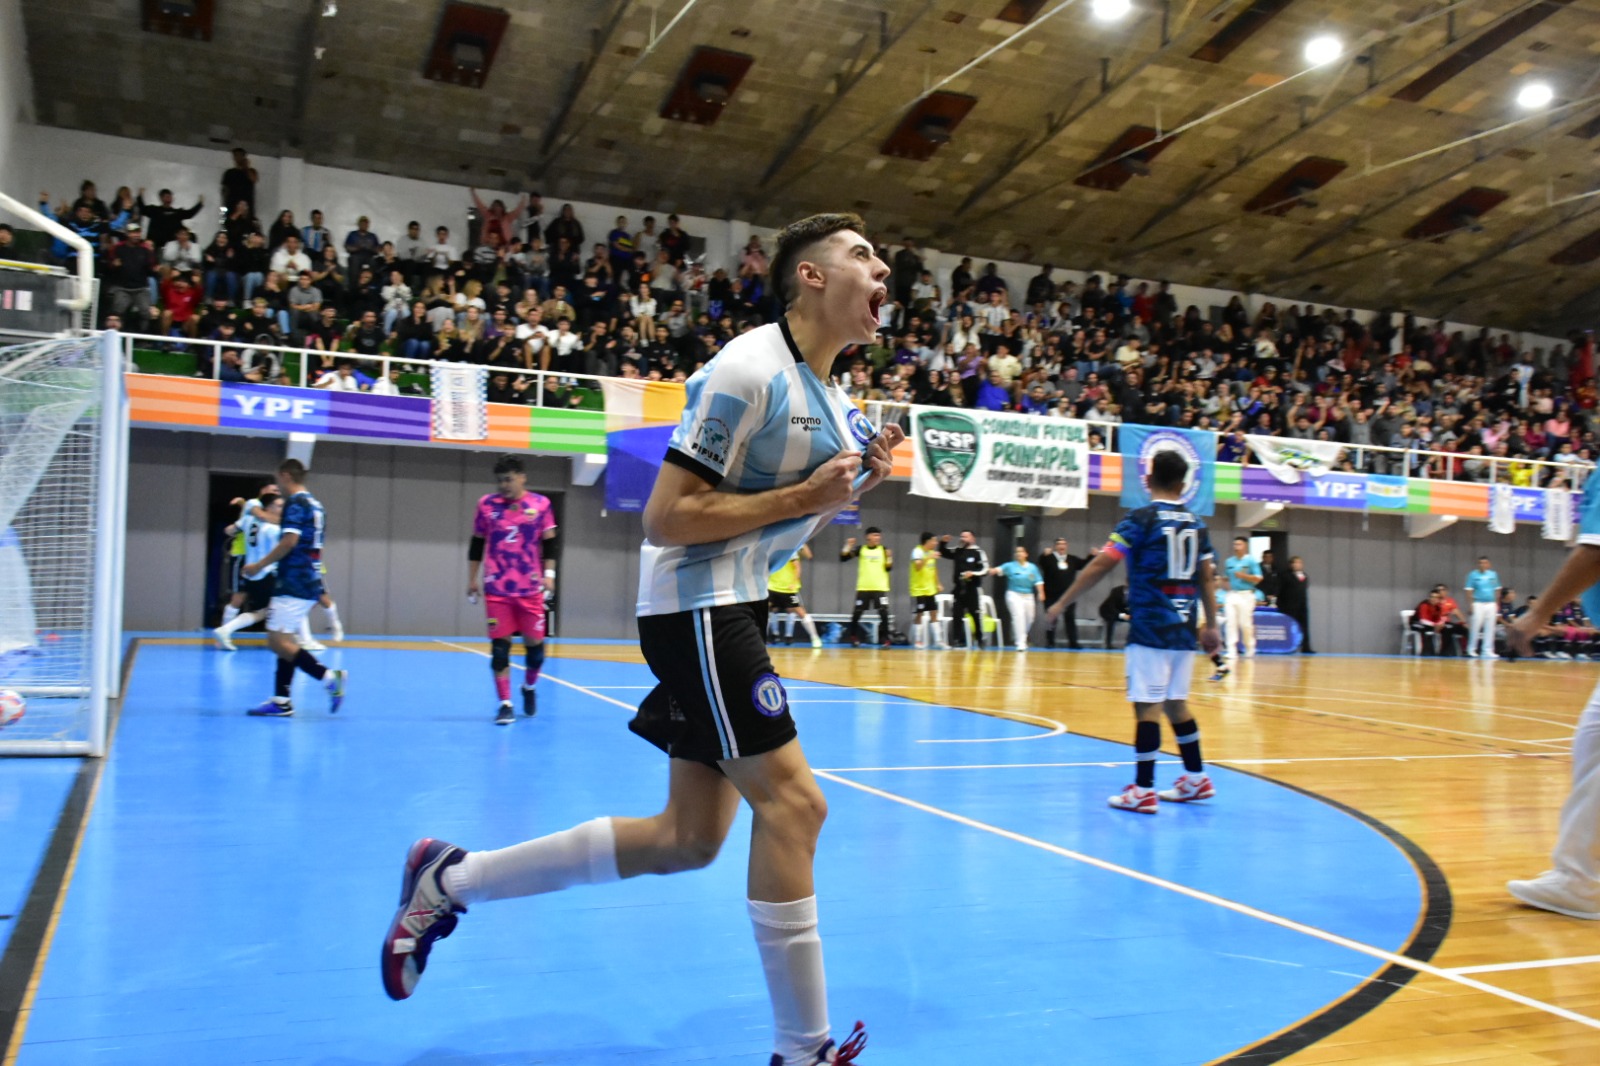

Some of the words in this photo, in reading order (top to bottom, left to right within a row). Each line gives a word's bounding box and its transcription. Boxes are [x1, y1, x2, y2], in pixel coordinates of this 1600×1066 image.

[233, 394, 316, 420] YPF
[791, 416, 822, 425] cromo
[924, 428, 975, 449] CFSP
[691, 442, 725, 466] FIFUSA
[991, 441, 1080, 472] PRINCIPAL
[1314, 480, 1363, 500] YPF
[504, 525, 519, 543] 2
[1160, 526, 1199, 580] 10
